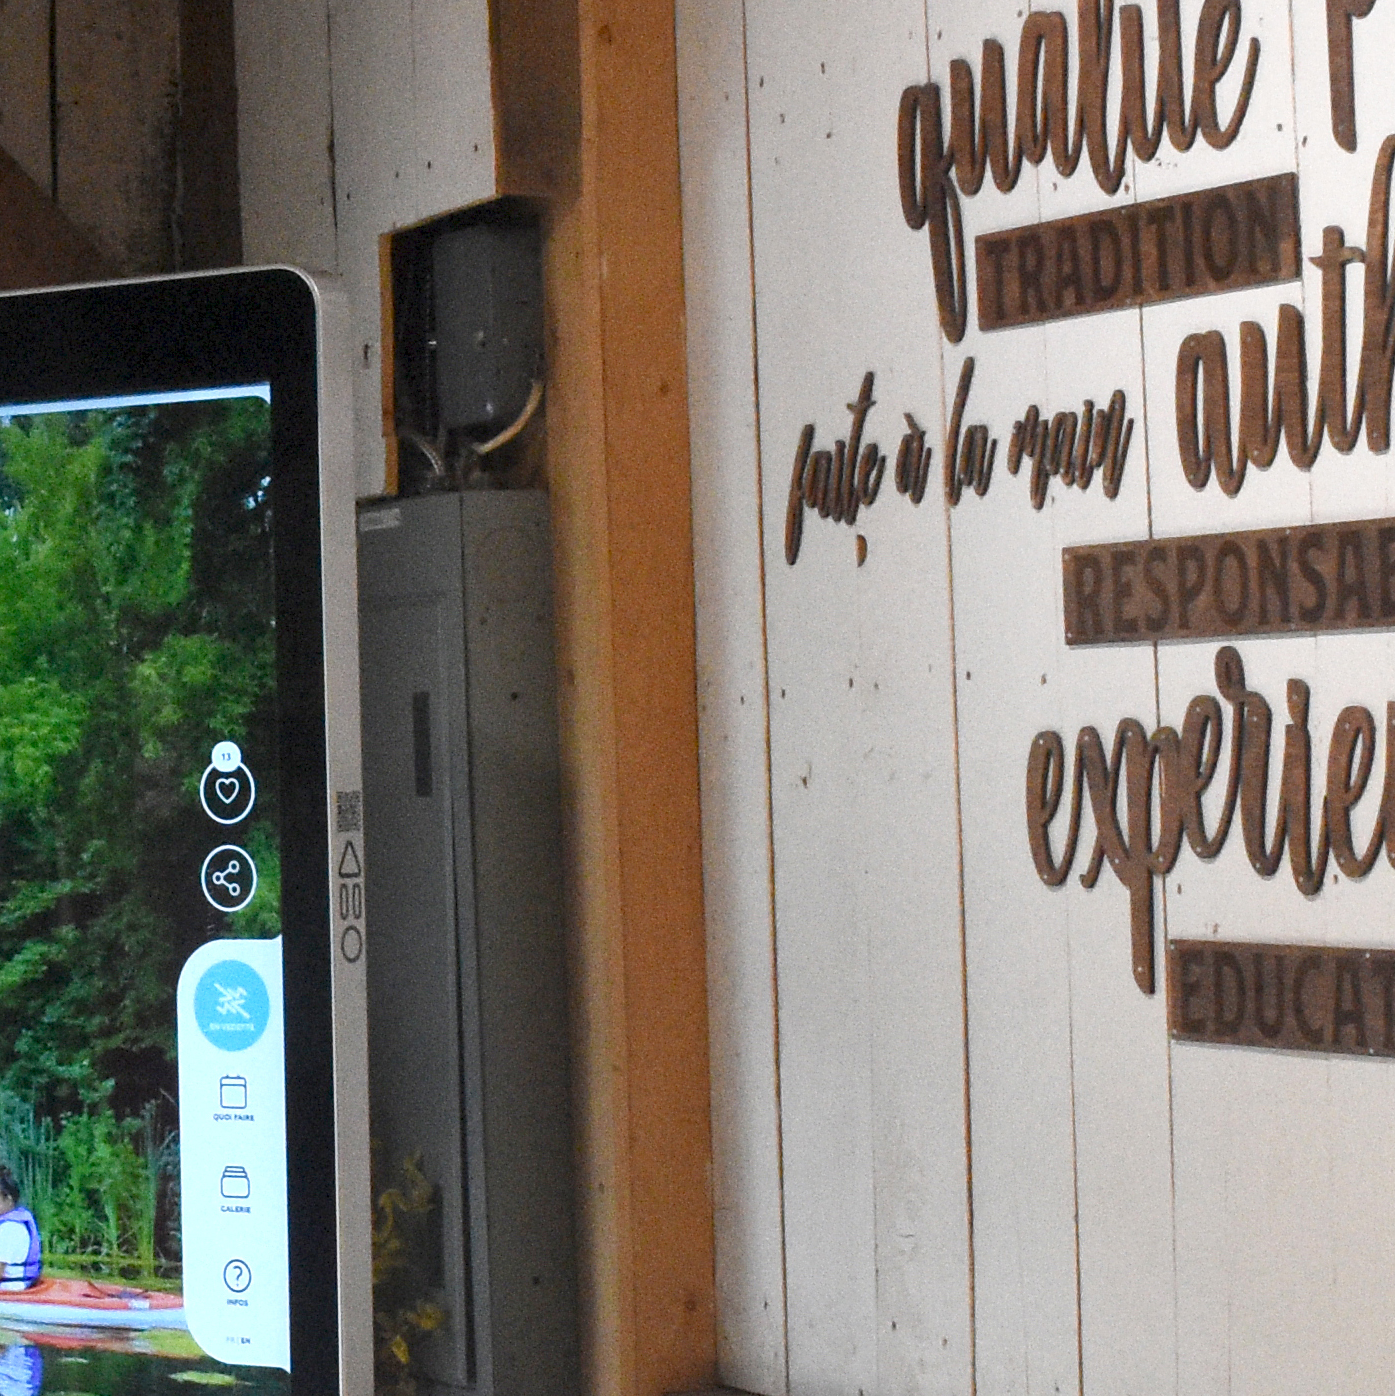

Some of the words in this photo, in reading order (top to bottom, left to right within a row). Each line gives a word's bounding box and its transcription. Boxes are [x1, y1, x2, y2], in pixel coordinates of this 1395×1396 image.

[984, 186, 1283, 321] TRADITION
[895, 412, 932, 507] à
[944, 356, 998, 507] la
[1026, 645, 1395, 995] experie
[213, 1113, 232, 1122] QUOI
[234, 1114, 255, 1122] FAIRE
[220, 1205, 251, 1214] GALERIE
[226, 1299, 249, 1307] INFOS
